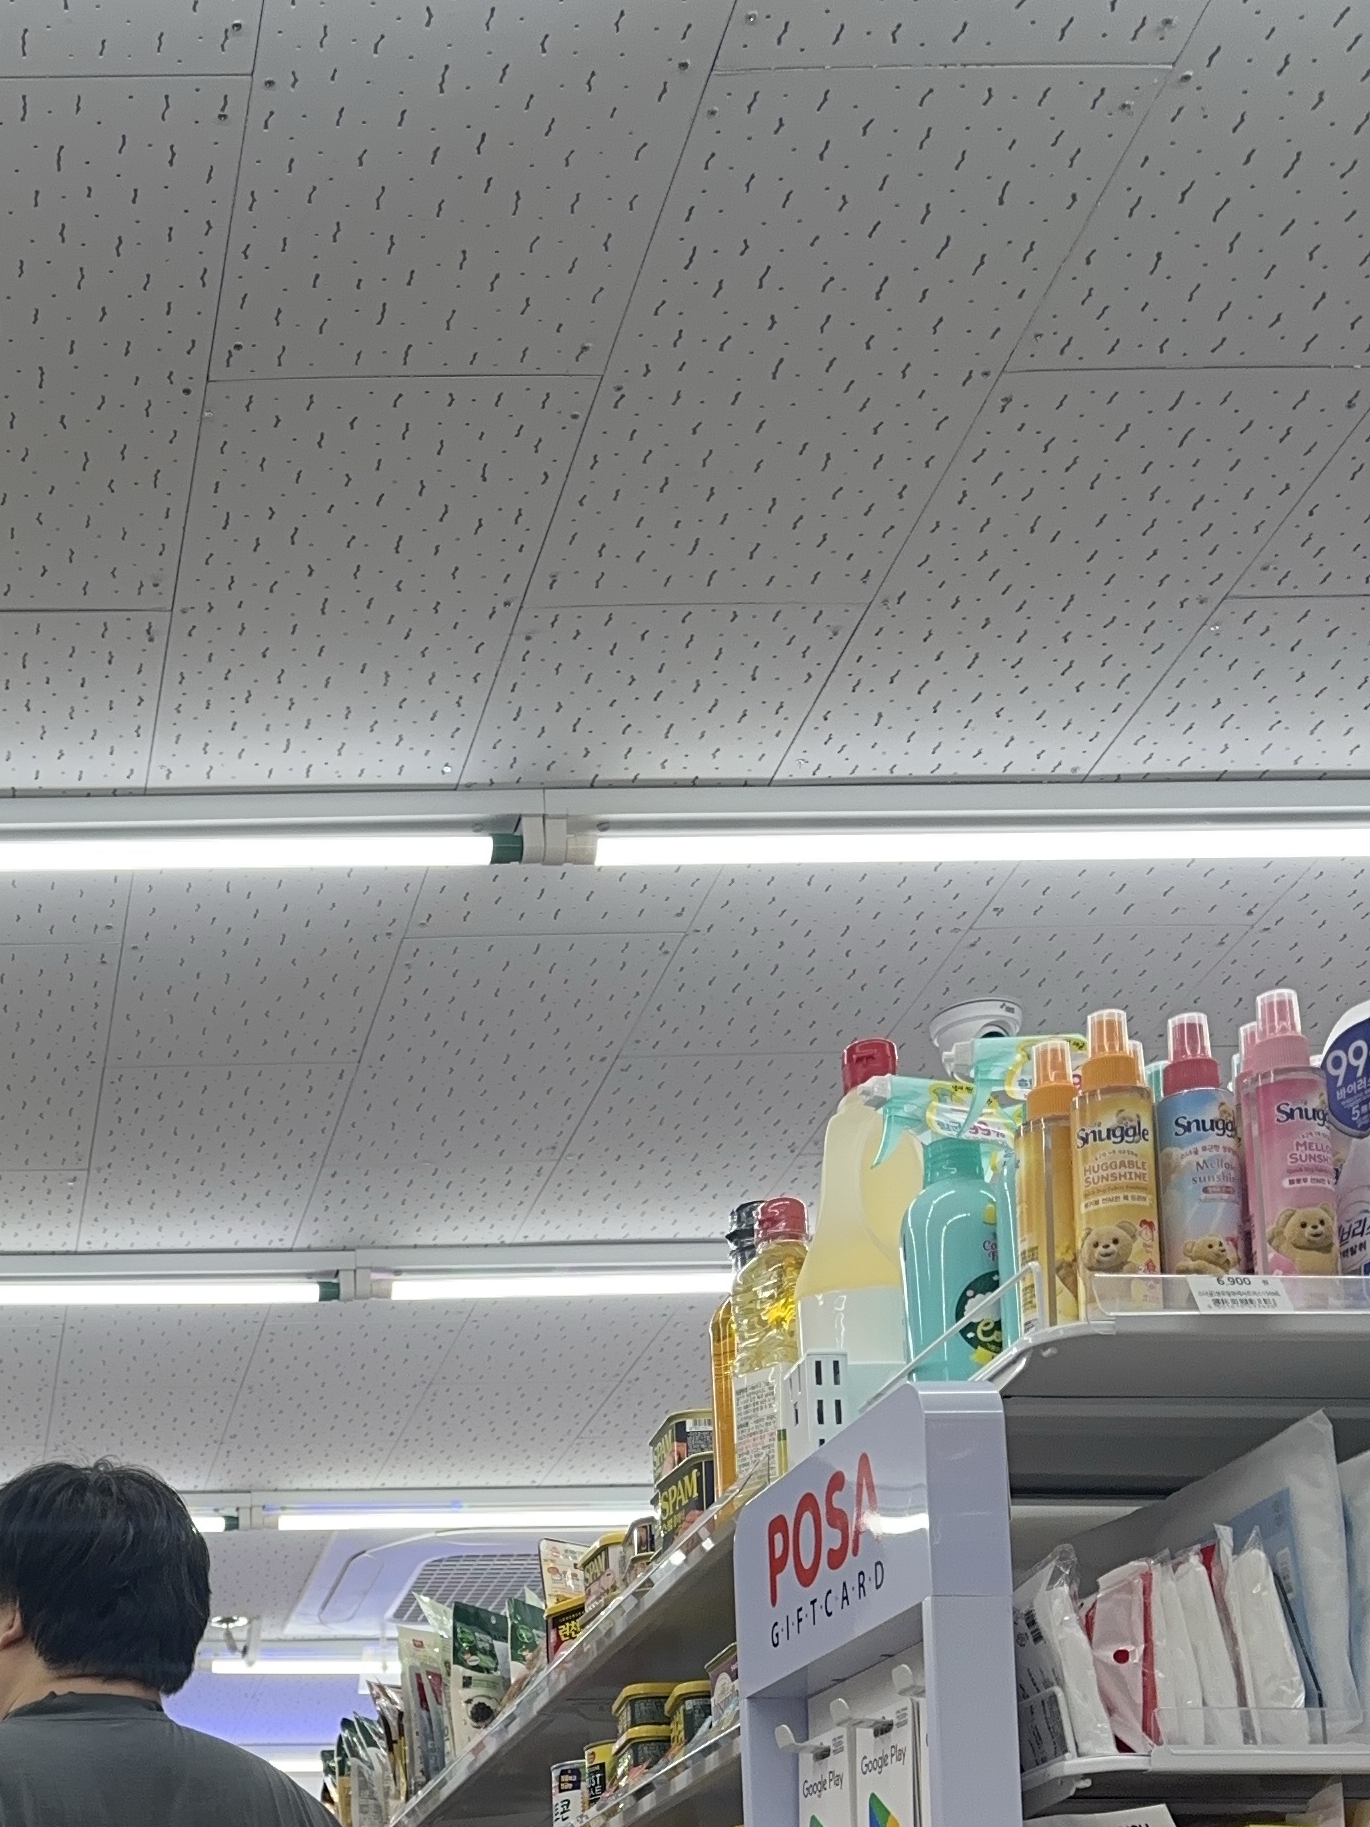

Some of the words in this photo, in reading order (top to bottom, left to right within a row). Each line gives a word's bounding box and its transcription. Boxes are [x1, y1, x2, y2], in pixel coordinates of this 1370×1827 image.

[1076, 1119, 1150, 1151] Snuggle
[1083, 1159, 1148, 1176] HUGGABLE
[1084, 1171, 1148, 1189] SUNSHINE
[660, 1468, 700, 1521] SPAM
[768, 1451, 880, 1608] POSA
[860, 1754, 889, 1775] Google
[890, 1745, 908, 1766] Play
[802, 1775, 828, 1799] Google
[828, 1770, 844, 1791] Play
